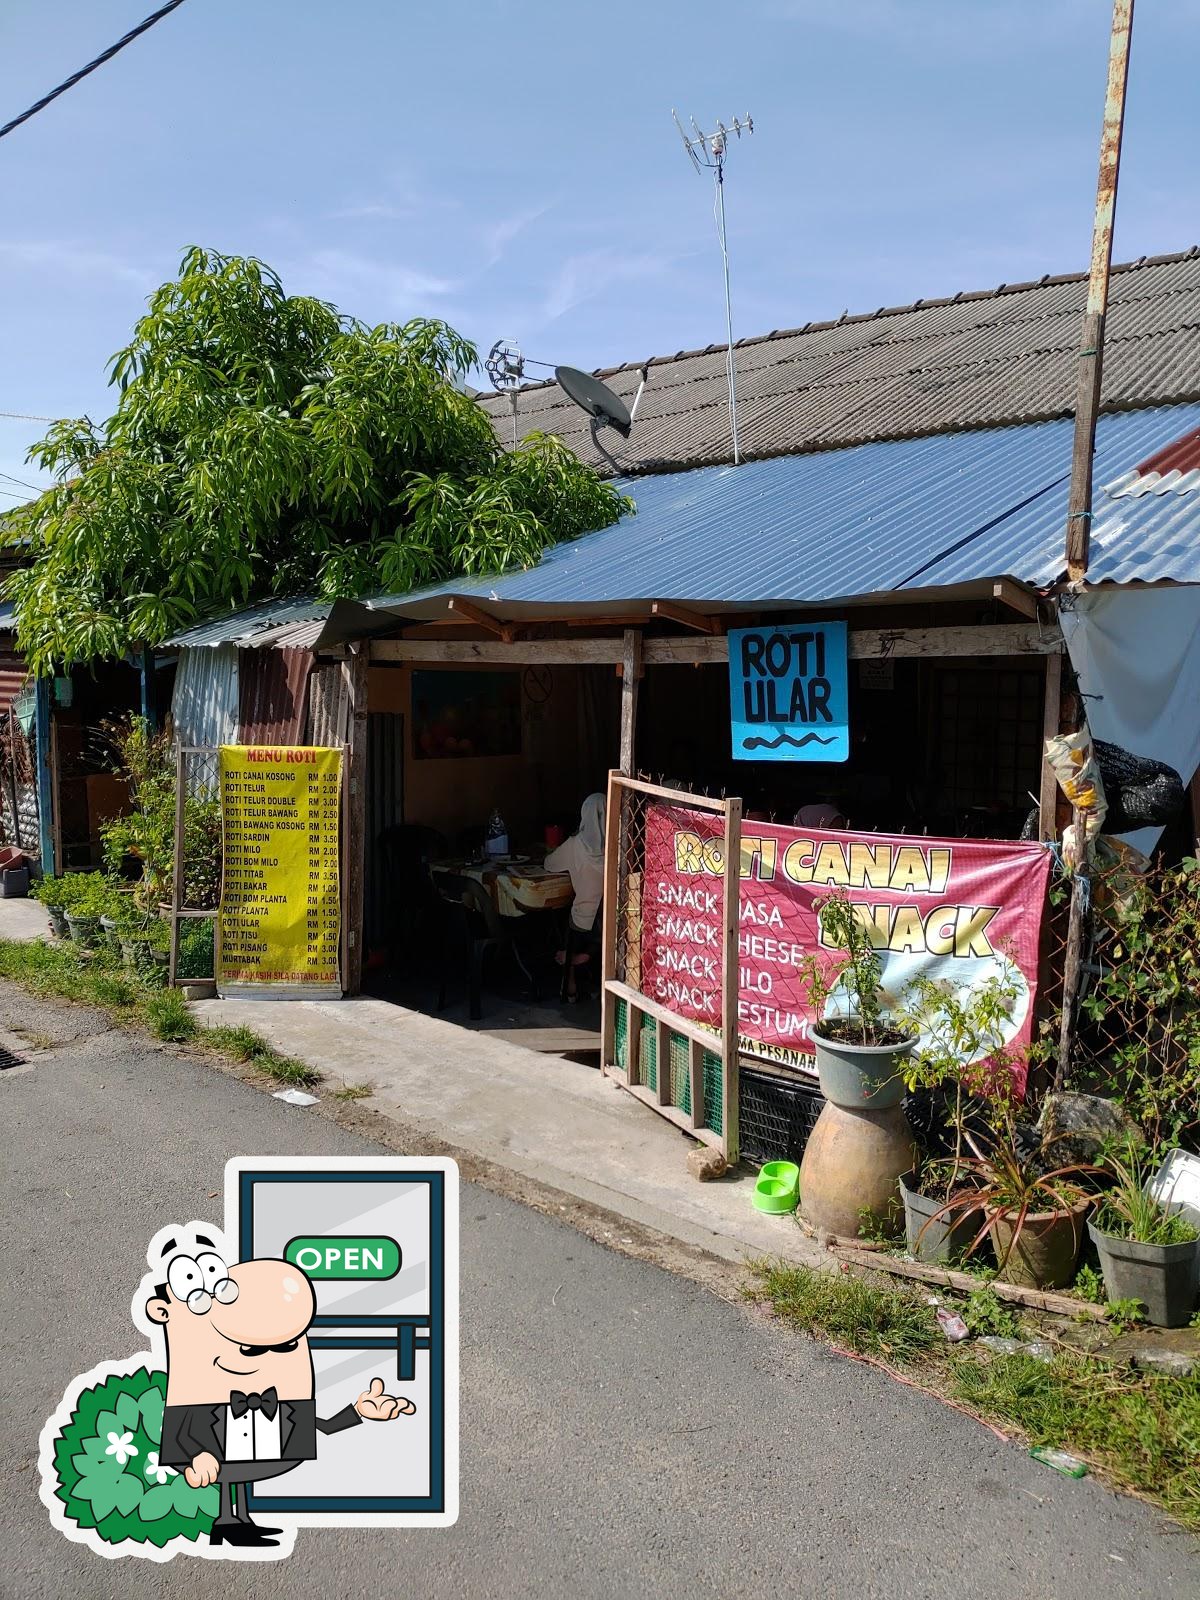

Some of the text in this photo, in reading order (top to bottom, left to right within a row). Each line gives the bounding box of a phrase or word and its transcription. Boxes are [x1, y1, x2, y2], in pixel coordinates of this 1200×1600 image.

[742, 632, 825, 677] ROTI
[744, 678, 833, 723] ULAR
[247, 749, 316, 763] MENU ROTI
[225, 772, 241, 780] ROTI
[243, 772, 264, 780] CANAI
[266, 773, 295, 781] KOSONG
[323, 774, 337, 782] 1.00
[225, 784, 242, 792] ROTI
[244, 784, 265, 793] TELUR
[323, 786, 337, 794] 2.00
[225, 796, 337, 807] ROTI TELUR DOUBLE RM 3.00
[225, 808, 337, 819] ROTI TELUR BAWANG RM 2.50
[225, 820, 337, 831] ROTI BAWANG KOSONG RM 1.50
[225, 833, 337, 843] ROTI SARDIN RM 3.50
[225, 845, 337, 856] ROTI MILO RM 2.00
[225, 857, 337, 868] ROTI BOM MILO RM 2.00
[675, 831, 952, 896] ROTI CANAI
[225, 869, 242, 878] ROTI
[309, 871, 319, 880] RM
[323, 872, 337, 881] 3.50
[225, 882, 337, 893] ROTI BAKAR RM 1.00
[224, 894, 337, 905] ROTI BOM PLANTA RM 1.50
[657, 882, 718, 915] SNACK
[223, 906, 337, 917] ROTI PLANTA RM 1.50
[222, 919, 337, 929] ROTI ULAR RM 1.50
[222, 931, 337, 941] ROTI TISU RM 1.50
[656, 913, 804, 967] SNACK HEESE
[222, 943, 337, 953] ROTI PISANG RM 3.00
[222, 955, 337, 966] MURTABAK RM 3.00
[656, 945, 773, 994] SNACK ILO
[273, 972, 290, 981] SILA
[291, 972, 319, 981] DATANG
[320, 973, 337, 981] LAGI
[656, 976, 716, 1013] SNACK
[738, 1001, 809, 1040] ESTUM
[759, 1043, 816, 1070] PESANAN
